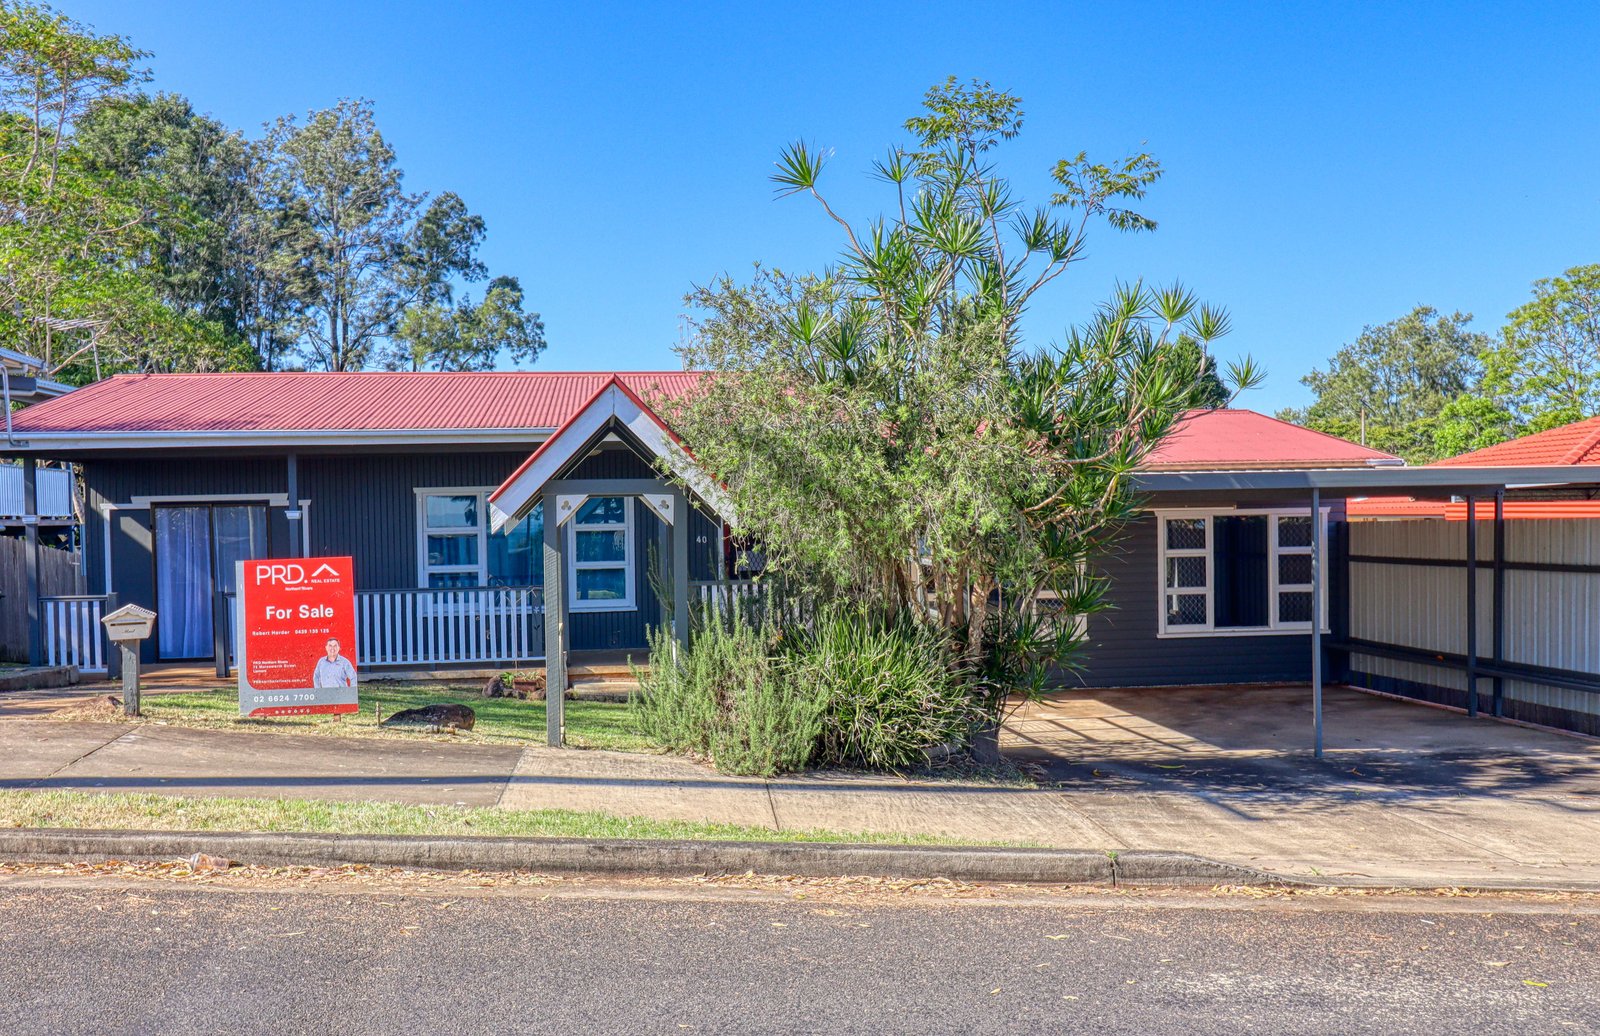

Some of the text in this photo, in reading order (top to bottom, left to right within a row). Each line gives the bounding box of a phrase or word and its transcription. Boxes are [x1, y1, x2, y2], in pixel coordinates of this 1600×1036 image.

[696, 535, 708, 544] 40
[266, 604, 334, 620] For Sale
[267, 694, 290, 702] 6624
